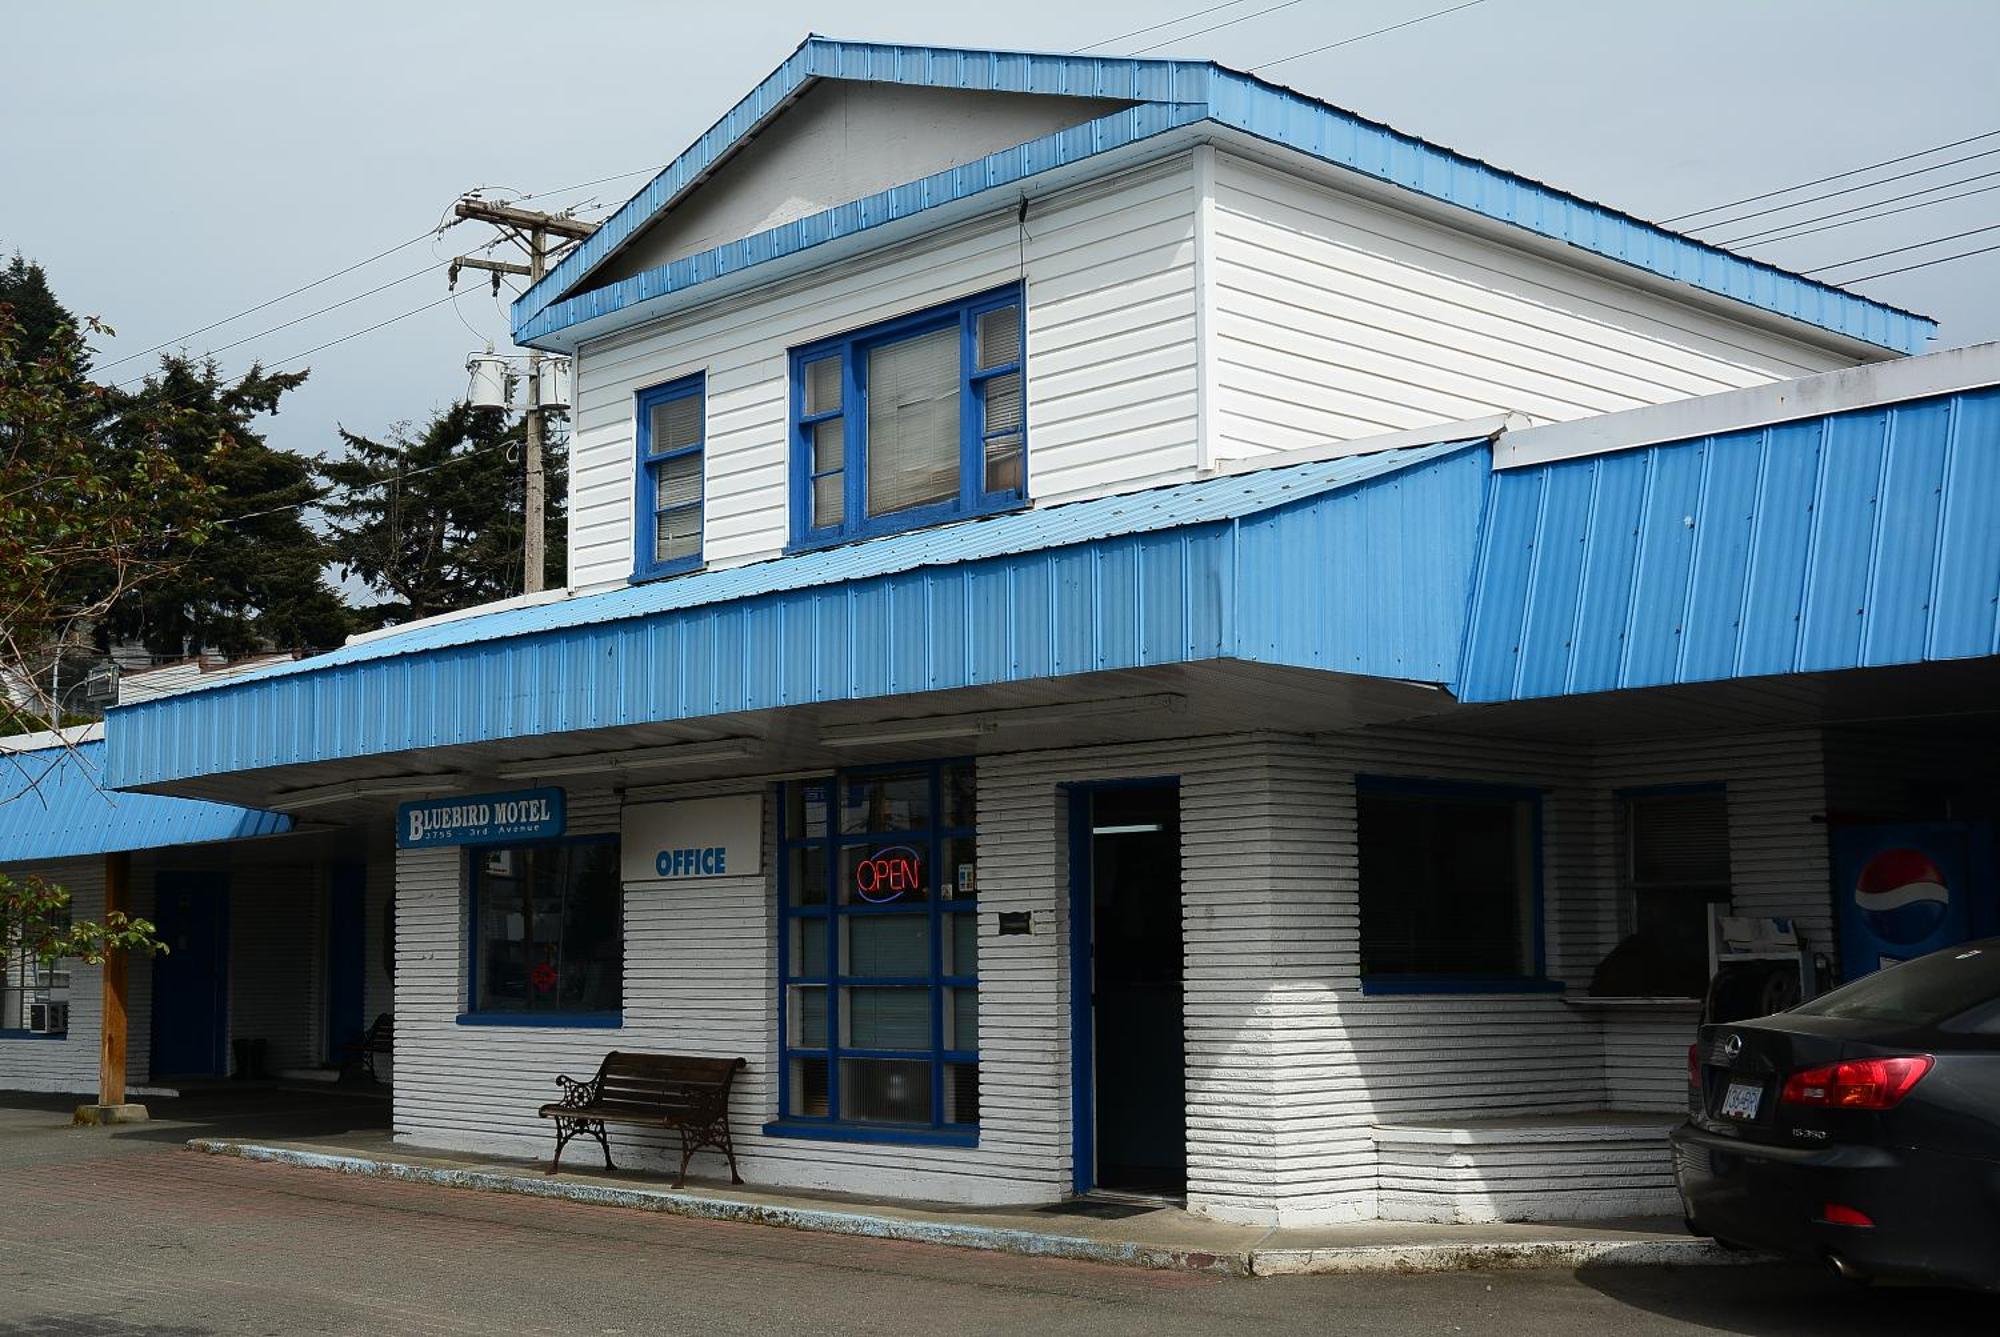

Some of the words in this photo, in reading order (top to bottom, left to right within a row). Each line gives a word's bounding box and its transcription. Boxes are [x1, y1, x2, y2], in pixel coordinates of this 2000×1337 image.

[409, 804, 490, 841] BLUEBIRD
[494, 799, 551, 825] MOTEL
[469, 828, 489, 837] 3rd
[498, 824, 541, 834] Avenue
[655, 847, 726, 876] OFFICE
[857, 859, 919, 891] OPEN
